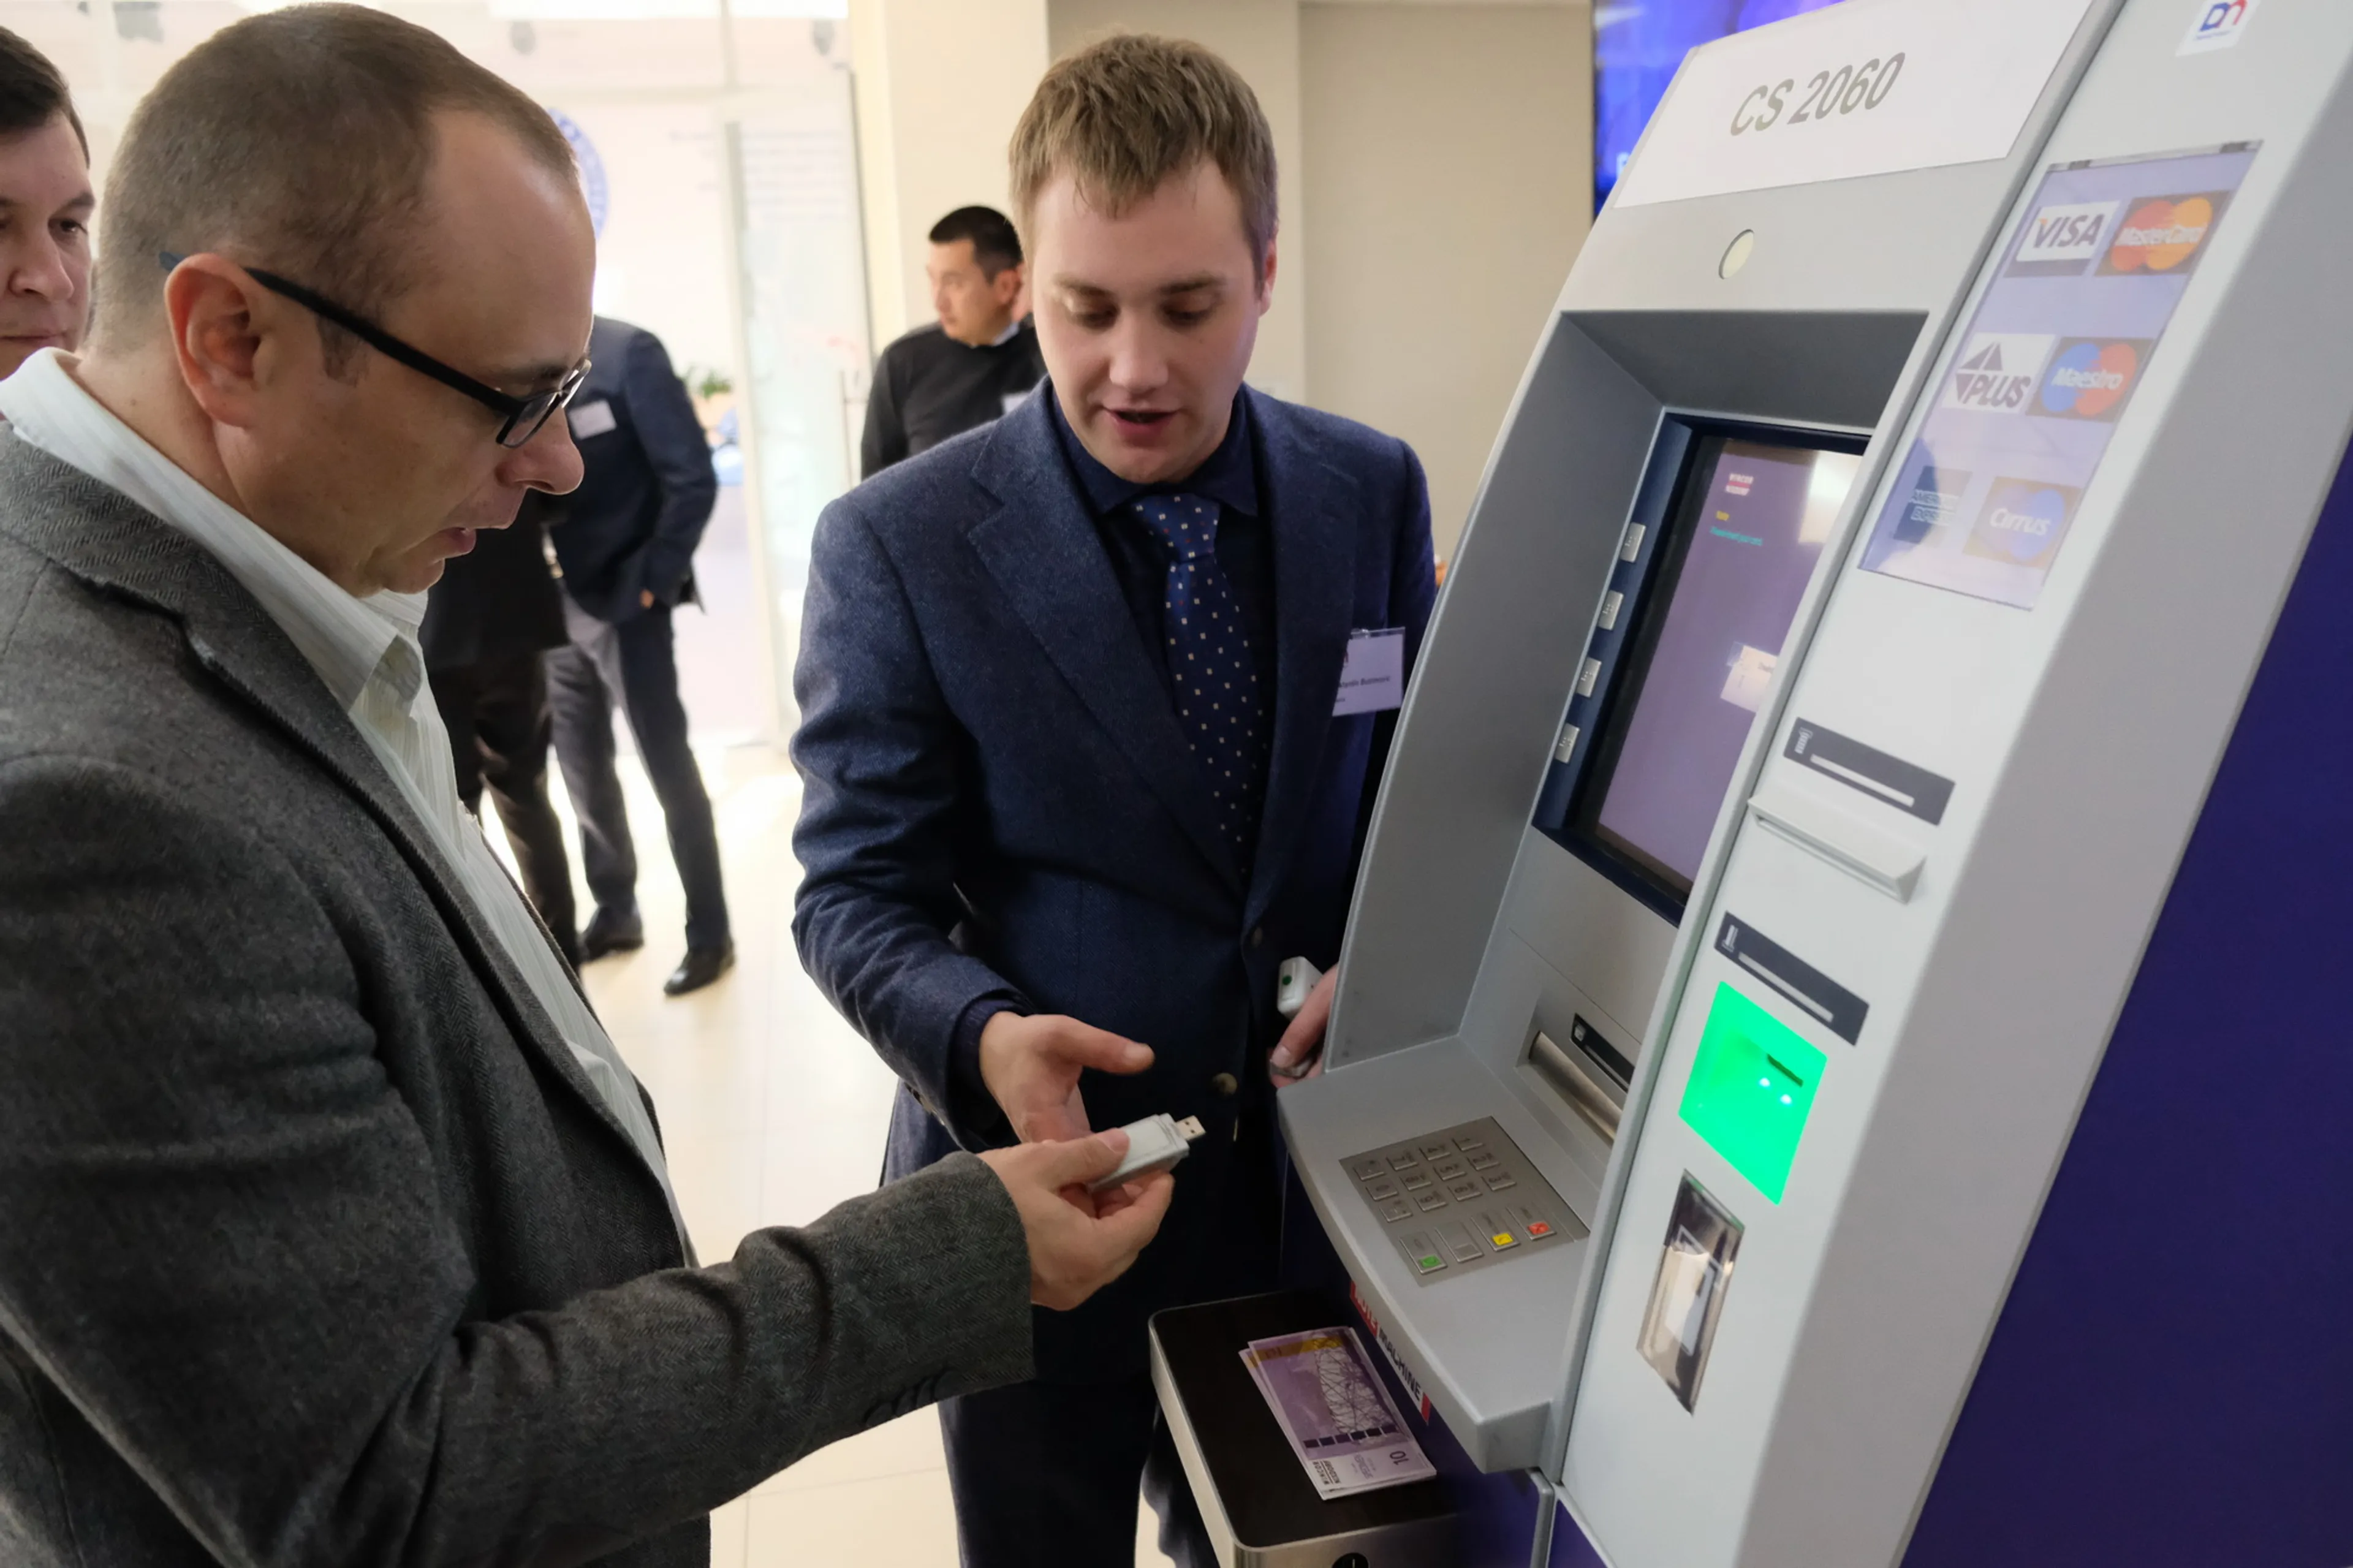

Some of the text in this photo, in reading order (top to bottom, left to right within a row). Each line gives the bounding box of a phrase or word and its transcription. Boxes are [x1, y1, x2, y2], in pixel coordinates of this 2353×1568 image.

[1730, 52, 1906, 136] CS 2060
[2033, 213, 2105, 249] VISA
[1962, 374, 2031, 408] PLUS
[2052, 367, 2124, 390] Maestro
[1990, 508, 2052, 536] Cirrus
[1389, 1450, 1409, 1466] 10
